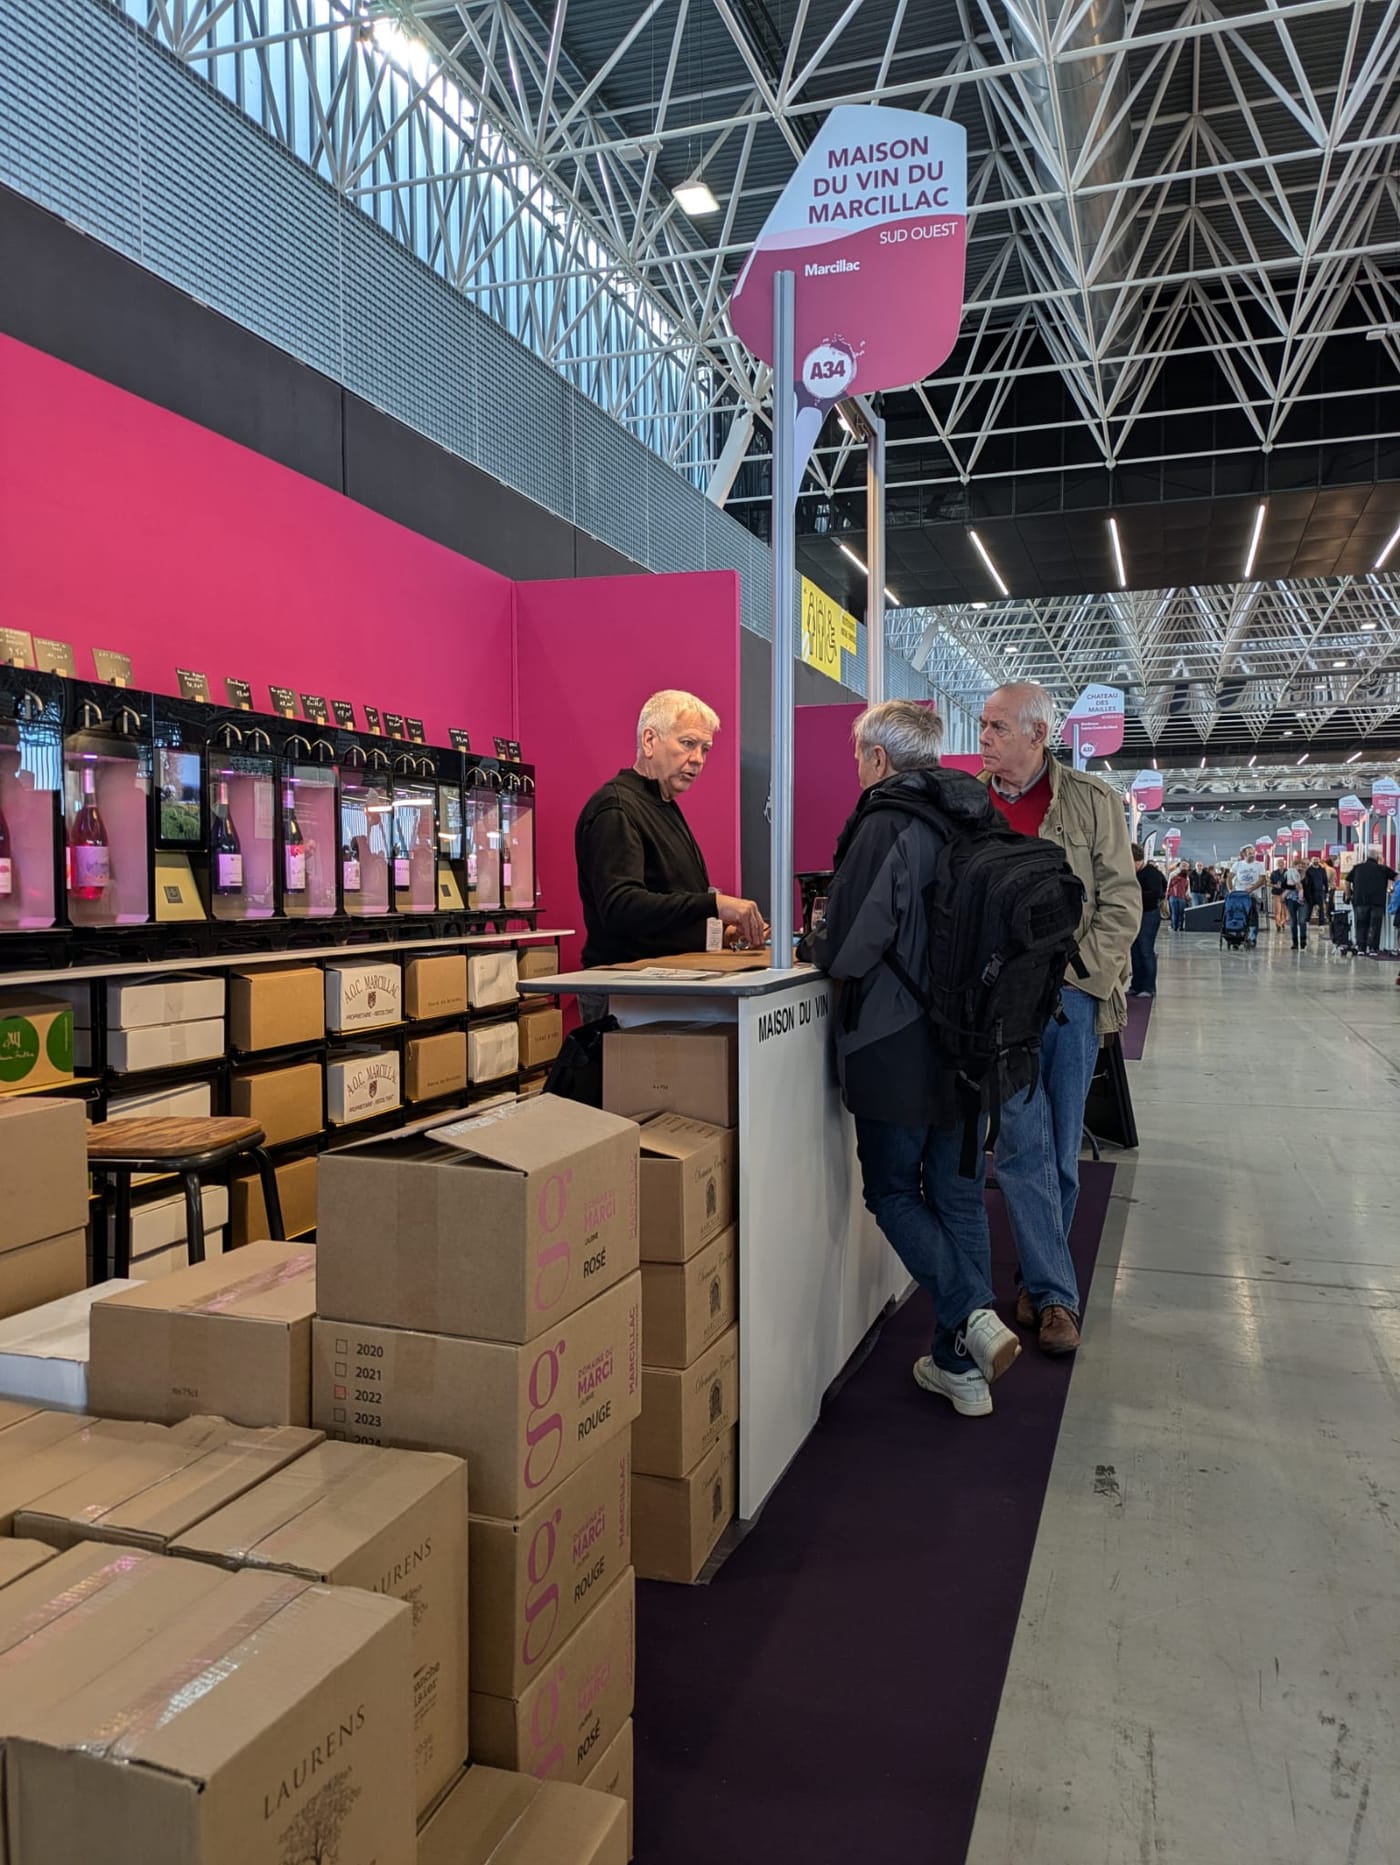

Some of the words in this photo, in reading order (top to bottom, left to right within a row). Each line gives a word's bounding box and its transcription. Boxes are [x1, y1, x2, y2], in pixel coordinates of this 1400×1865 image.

[828, 136, 929, 169] MAISON
[813, 177, 848, 198] DU
[856, 166, 899, 191] VIN
[908, 160, 944, 184] DU
[808, 187, 949, 225] MARCILLAC
[879, 227, 907, 245] SUD
[911, 221, 958, 242] OUEST
[804, 258, 860, 277] Marcillac
[810, 359, 846, 381] A34
[364, 974, 400, 999] MARCILLAC
[758, 1005, 795, 1043] MAISON
[799, 999, 811, 1026] DU
[815, 991, 829, 1018] VIN
[584, 1199, 616, 1232] MARCI
[584, 1247, 606, 1279] ROSÉ
[356, 1343, 384, 1358] 2020
[355, 1366, 382, 1381] 2021
[577, 1358, 613, 1399] MARCI
[355, 1389, 382, 1404] 2022
[354, 1412, 381, 1427] 2023
[577, 1400, 611, 1441] ROUGE
[572, 1513, 606, 1564] MARCI
[574, 1555, 605, 1604] ROUGE
[577, 1717, 602, 1766] ROSÉ
[263, 1703, 366, 1821] LAURENS
